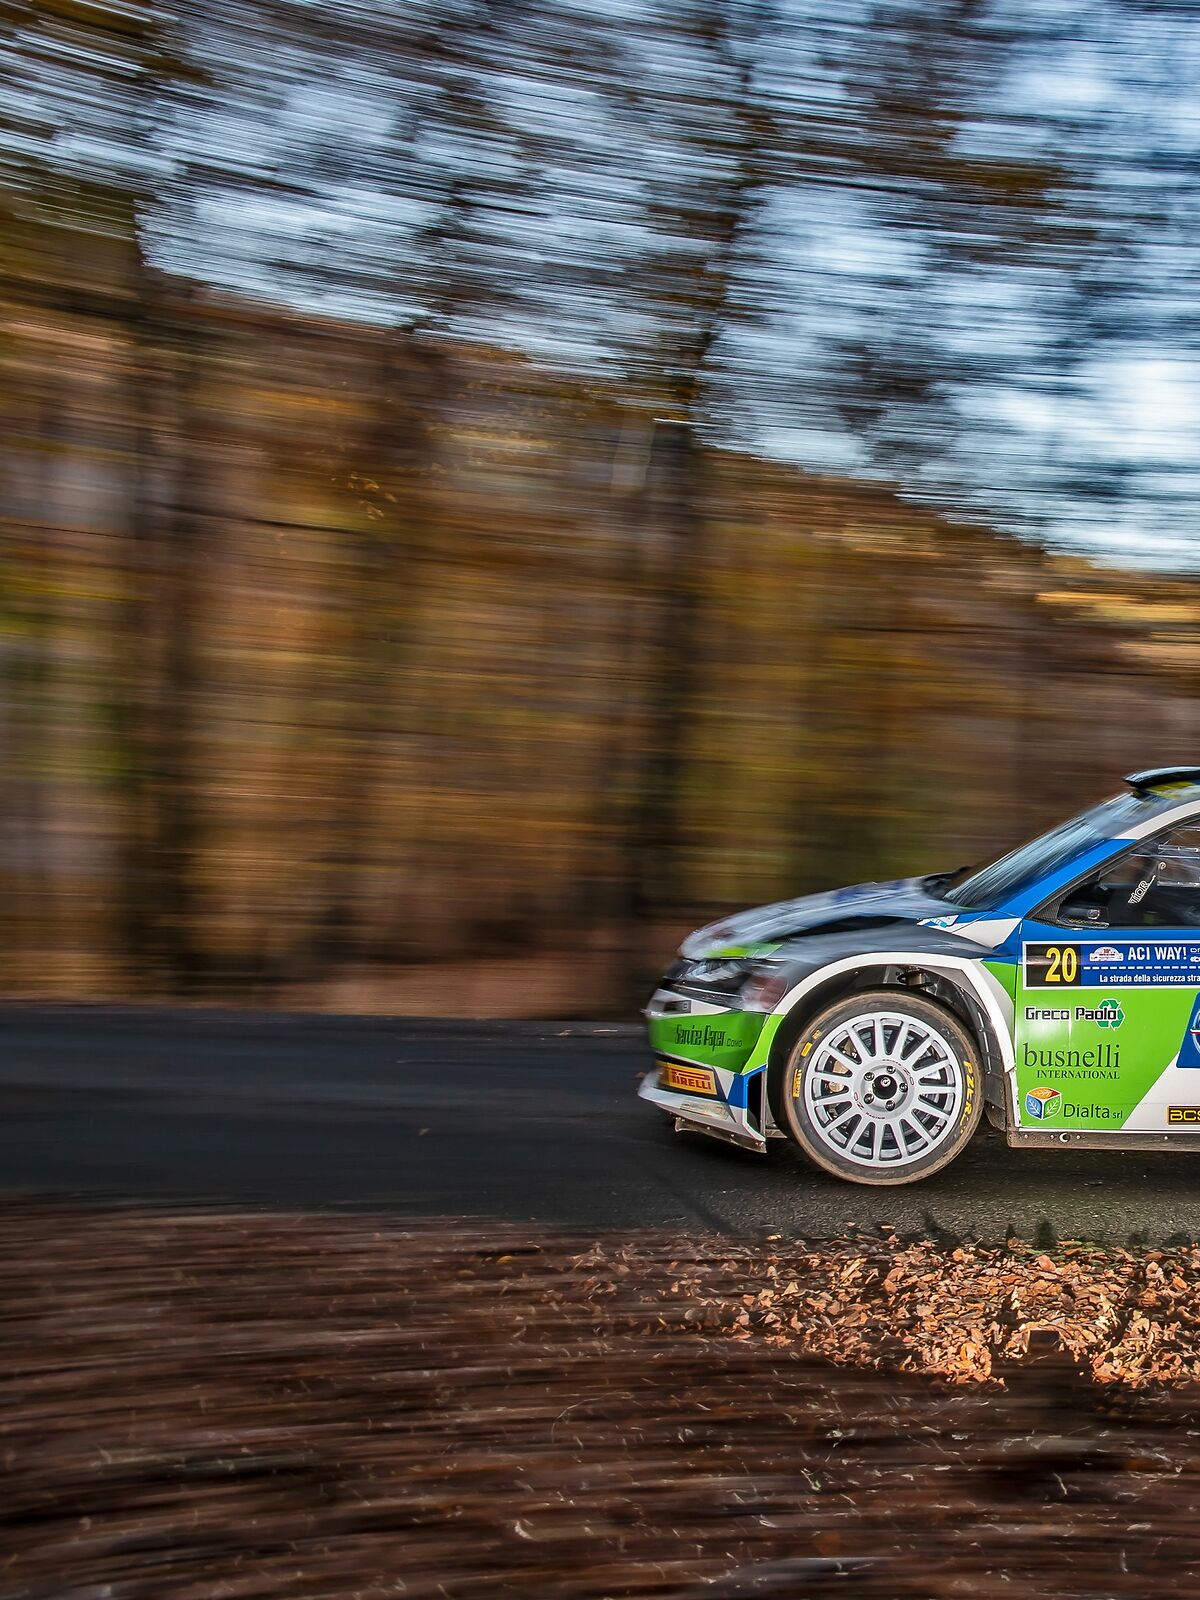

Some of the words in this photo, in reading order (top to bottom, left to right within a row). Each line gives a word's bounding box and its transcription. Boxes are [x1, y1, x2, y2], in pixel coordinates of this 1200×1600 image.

[1127, 946, 1151, 961] ACI
[1154, 946, 1188, 961] WAY!
[1045, 947, 1078, 983] 20
[1099, 974, 1108, 983] La
[1109, 974, 1133, 983] strada
[1134, 974, 1151, 983] della
[1152, 974, 1186, 983] sicurezza
[1025, 1006, 1070, 1021] Greco
[1075, 1006, 1117, 1021] Paolo
[675, 1024, 703, 1046] Service
[703, 1025, 727, 1051] Paper
[1022, 1042, 1120, 1068] busnelli
[671, 1070, 712, 1090] PIRELLI
[1037, 1069, 1120, 1079] INTERNATIONAL
[1062, 1102, 1111, 1120] Dialta
[1112, 1109, 1124, 1120] srl
